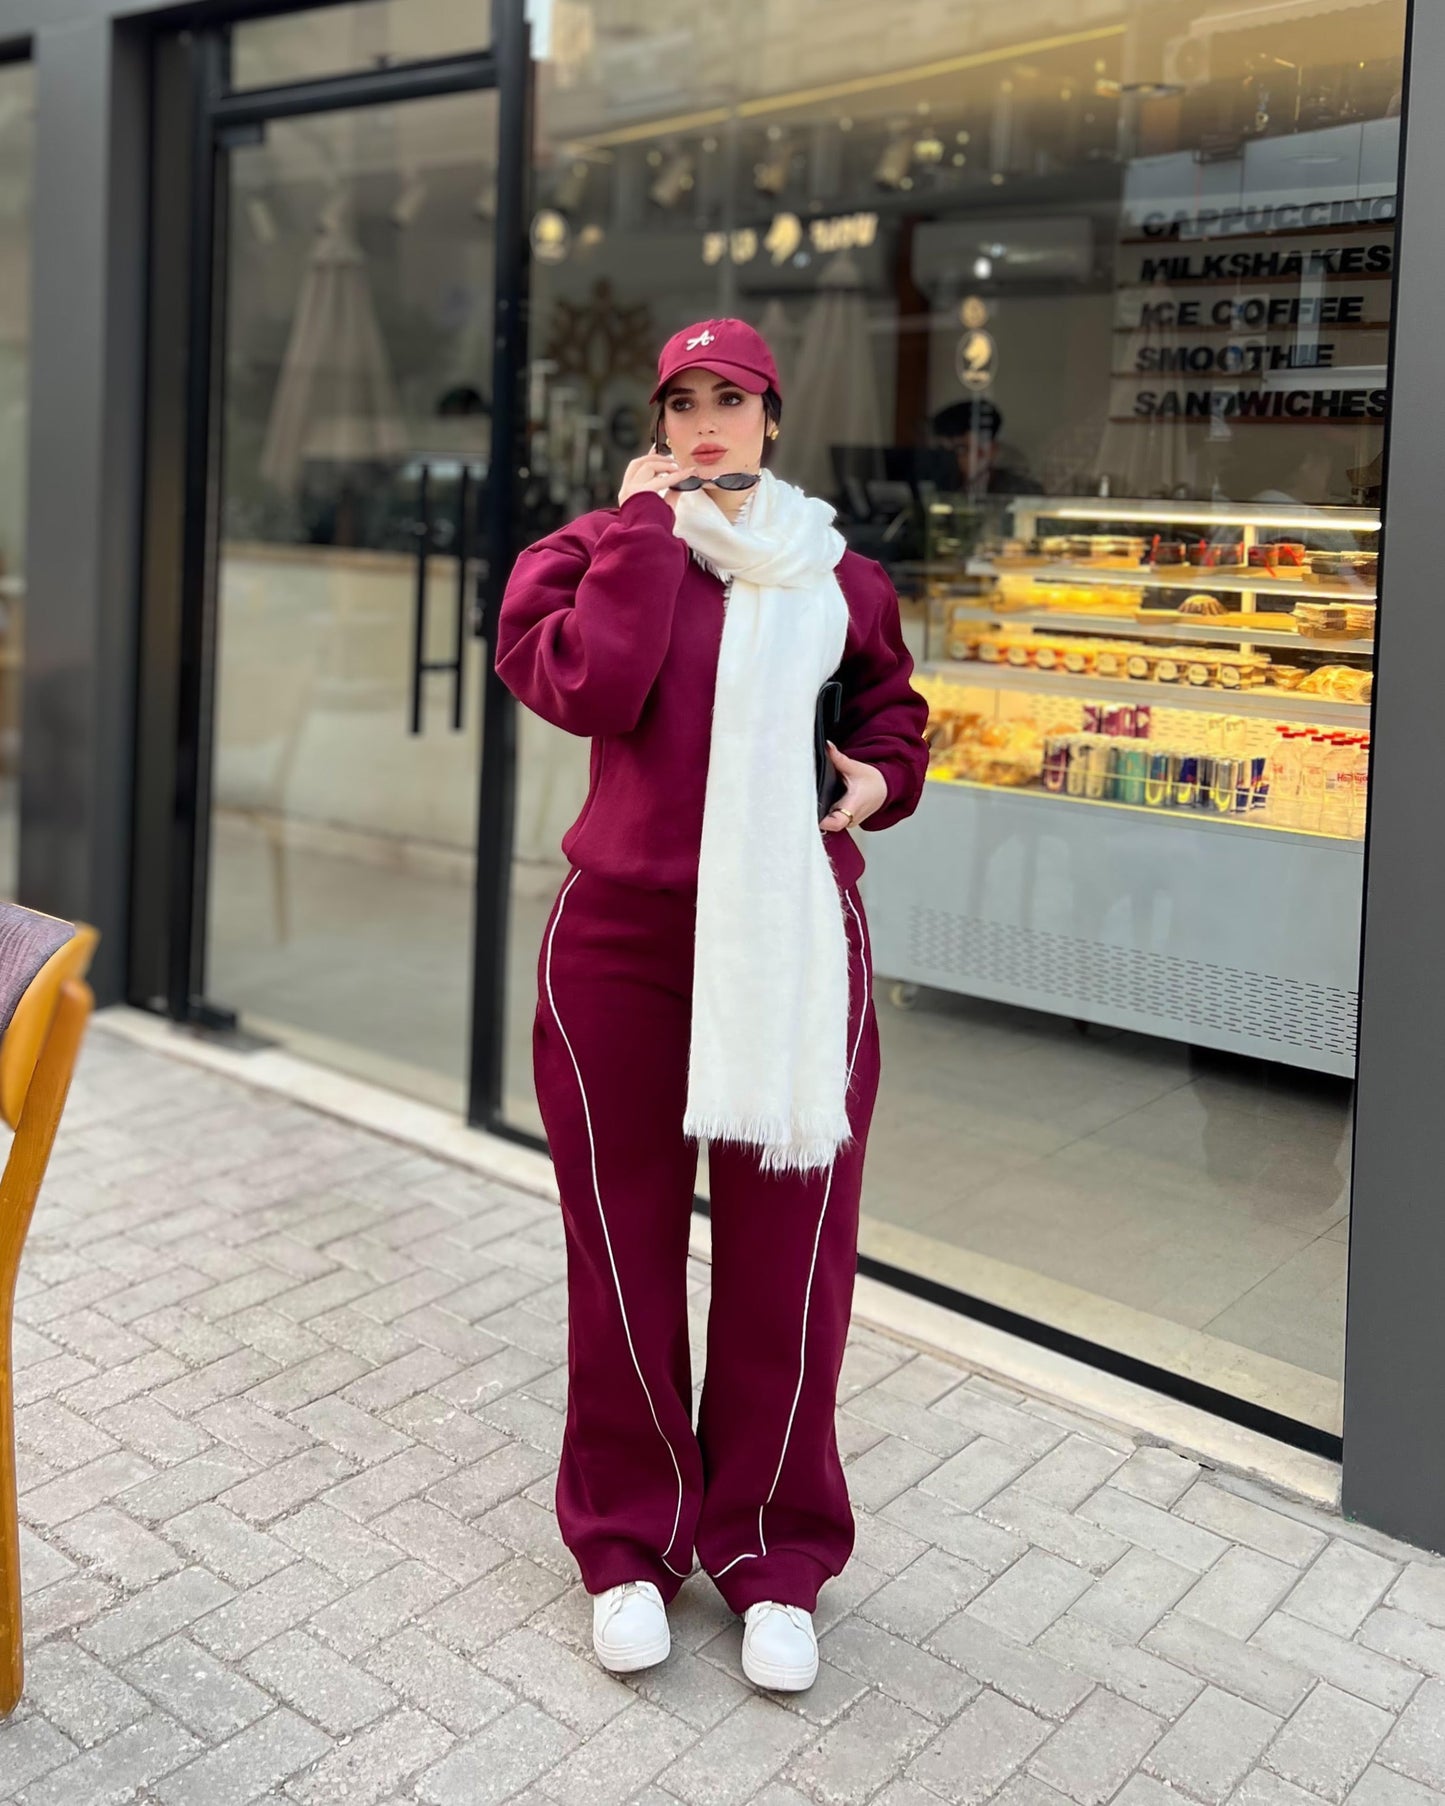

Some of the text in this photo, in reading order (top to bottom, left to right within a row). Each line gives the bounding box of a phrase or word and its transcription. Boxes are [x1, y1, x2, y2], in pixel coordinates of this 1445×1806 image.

[1142, 197, 1396, 236] CAPPUCCINO
[1141, 245, 1392, 281] MILKSHAKES
[1141, 297, 1364, 326] ICE COFFEE
[1135, 344, 1335, 372] SMOOTHIE
[1133, 389, 1388, 417] SANDWICHES
